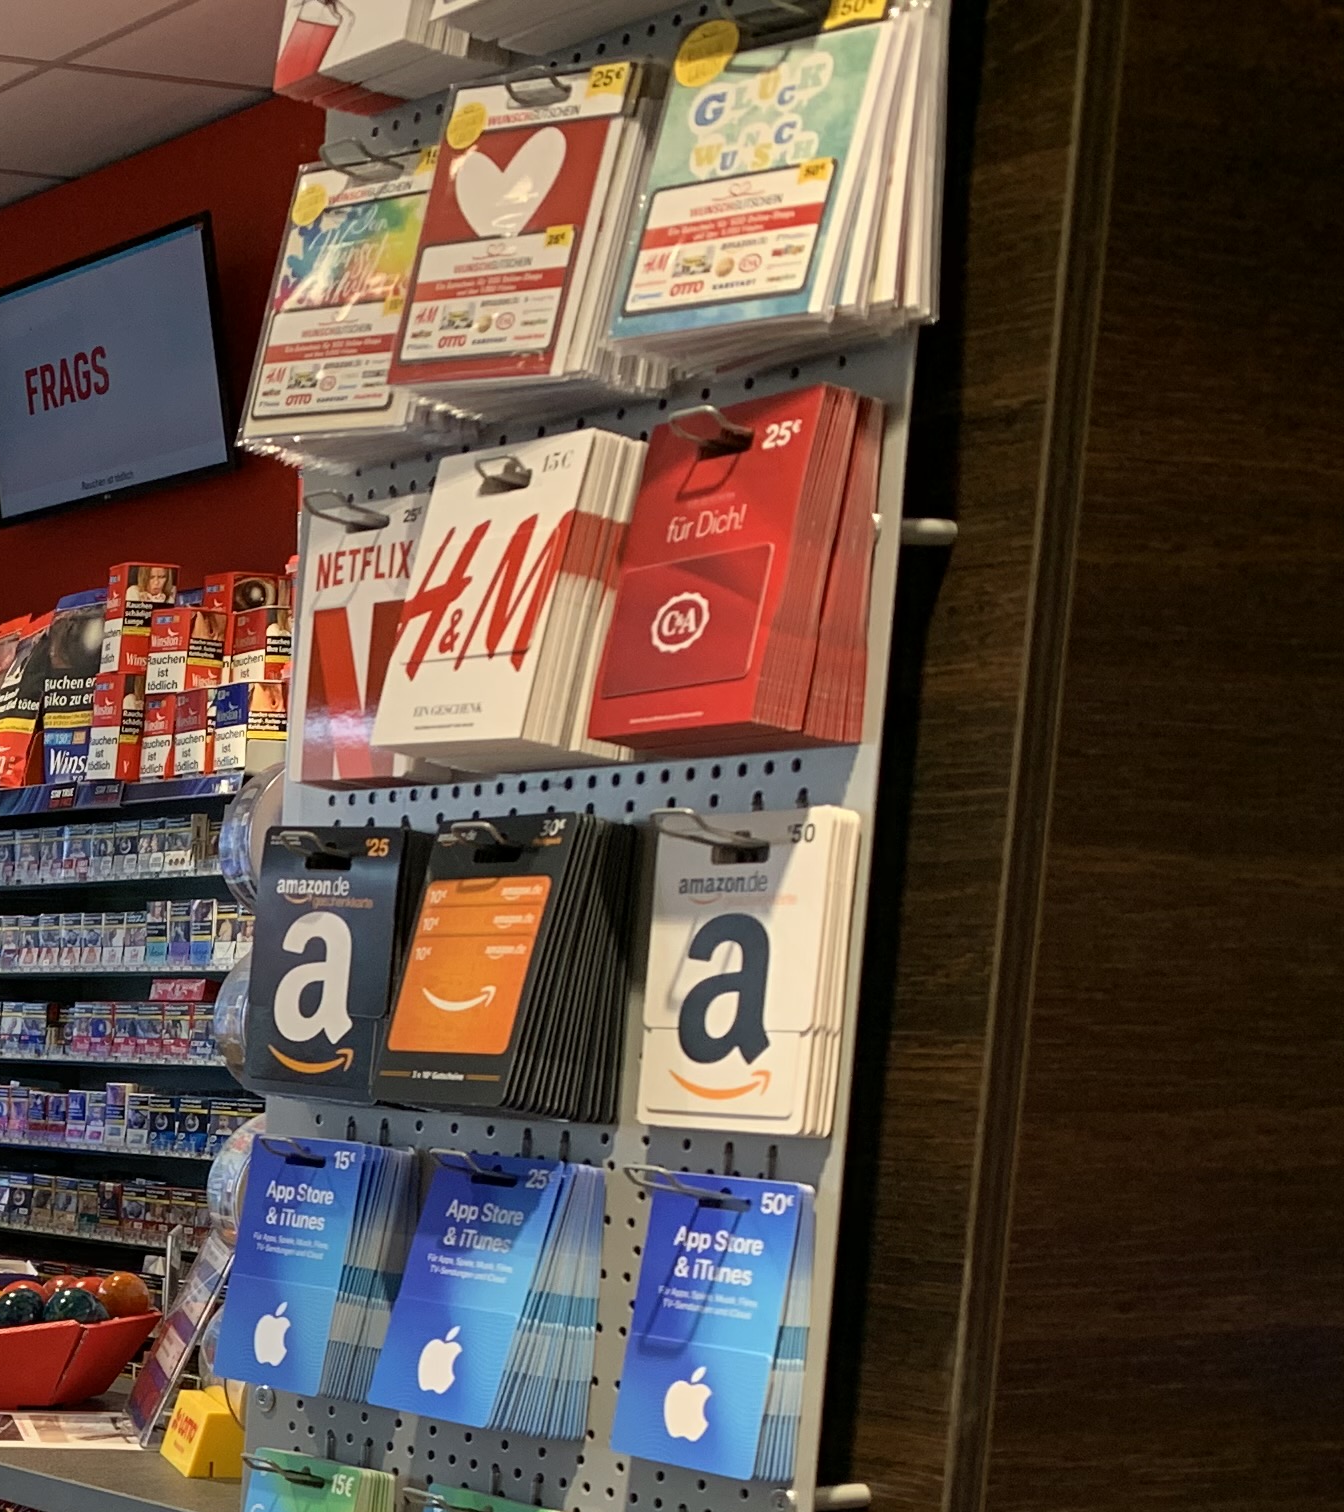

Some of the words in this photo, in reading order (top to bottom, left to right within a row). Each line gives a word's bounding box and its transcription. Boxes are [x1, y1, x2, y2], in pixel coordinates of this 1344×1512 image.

[592, 68, 624, 90] 25€
[437, 334, 467, 349] OTTO
[24, 345, 110, 416] FRAGS
[285, 393, 313, 407] OTTO
[761, 417, 803, 451] 25€
[666, 512, 694, 544] für
[695, 503, 748, 539] Dich!
[316, 538, 413, 593] NETFLIX
[125, 601, 153, 611] Rauchen
[395, 508, 577, 682] H&M
[124, 616, 144, 627] Lunge
[660, 612, 699, 639] C&A
[157, 667, 169, 678] ist
[147, 680, 178, 691] tödlich
[413, 704, 434, 718] EIN
[539, 818, 566, 837] 30€
[276, 875, 351, 898] amazon.de
[429, 888, 448, 905] 10€
[422, 916, 440, 931] 10€
[333, 1150, 356, 1171] 15€
[265, 1179, 294, 1202] App
[296, 1184, 335, 1206] Store
[760, 1192, 795, 1218] 50€
[265, 1207, 278, 1226] &
[279, 1208, 326, 1232] iTunes
[445, 1199, 479, 1222] App
[480, 1203, 524, 1226] Store
[443, 1227, 456, 1247] &
[458, 1227, 512, 1255] iTunes
[673, 1225, 710, 1257] App
[713, 1230, 764, 1258] Store
[693, 1257, 754, 1288] iTunes
[330, 1473, 355, 1498] 15€
